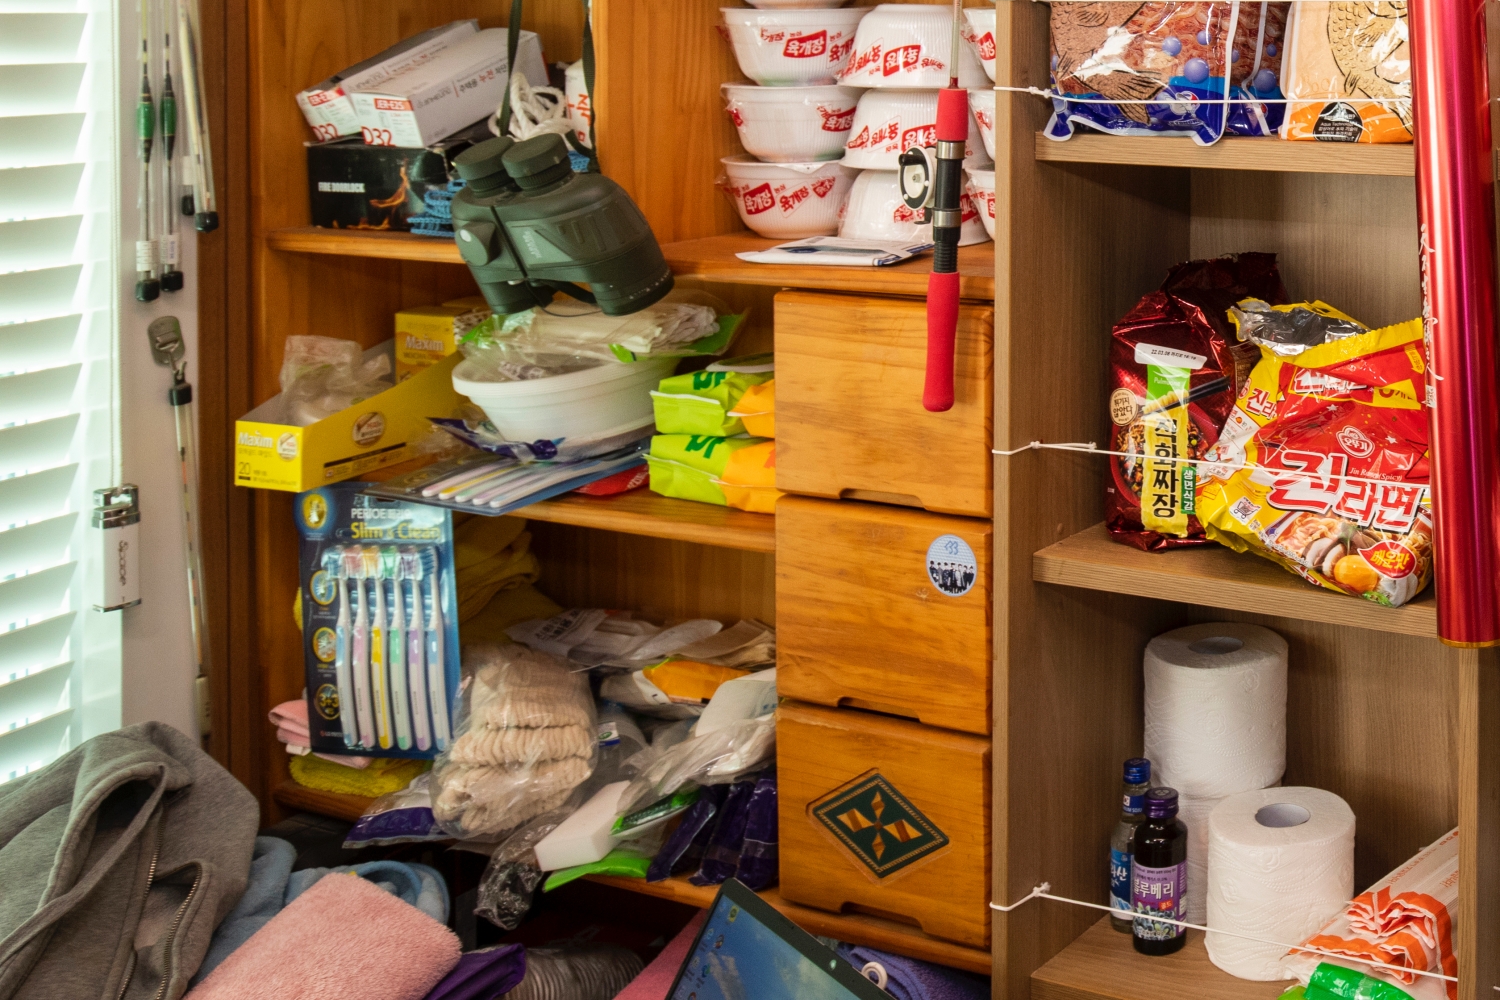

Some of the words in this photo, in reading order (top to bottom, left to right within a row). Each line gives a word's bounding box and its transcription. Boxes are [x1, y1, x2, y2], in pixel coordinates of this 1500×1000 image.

[785, 35, 825, 57] 육개장
[361, 125, 397, 147] D32
[406, 335, 445, 351] Maxim
[239, 431, 274, 448] Maxim
[238, 462, 250, 475] 20
[1152, 419, 1180, 518] 직화짜장
[1183, 469, 1195, 512] 생면식감
[1266, 449, 1425, 534] 진라면
[351, 508, 386, 519] PERIOE
[351, 522, 384, 539] Slim
[398, 522, 441, 539] Clean
[1370, 551, 1410, 571] 매운맛
